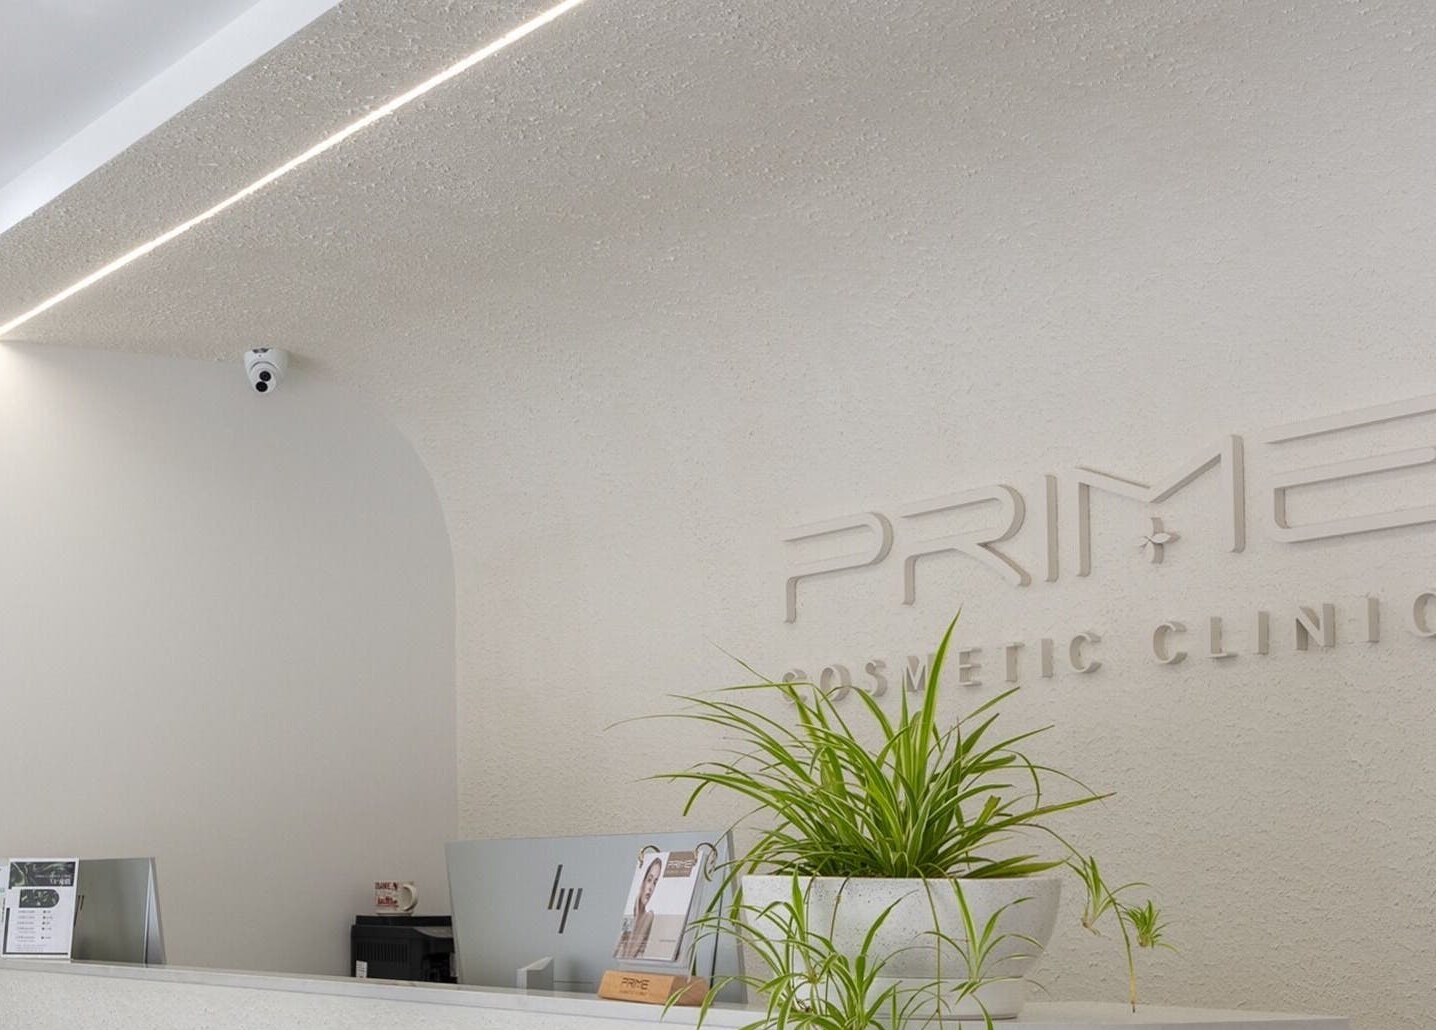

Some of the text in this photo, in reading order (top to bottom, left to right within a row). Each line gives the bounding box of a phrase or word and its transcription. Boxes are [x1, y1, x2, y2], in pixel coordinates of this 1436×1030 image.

[781, 394, 1436, 624] PRIME
[547, 864, 583, 934] hp
[621, 977, 650, 990] PRIME
